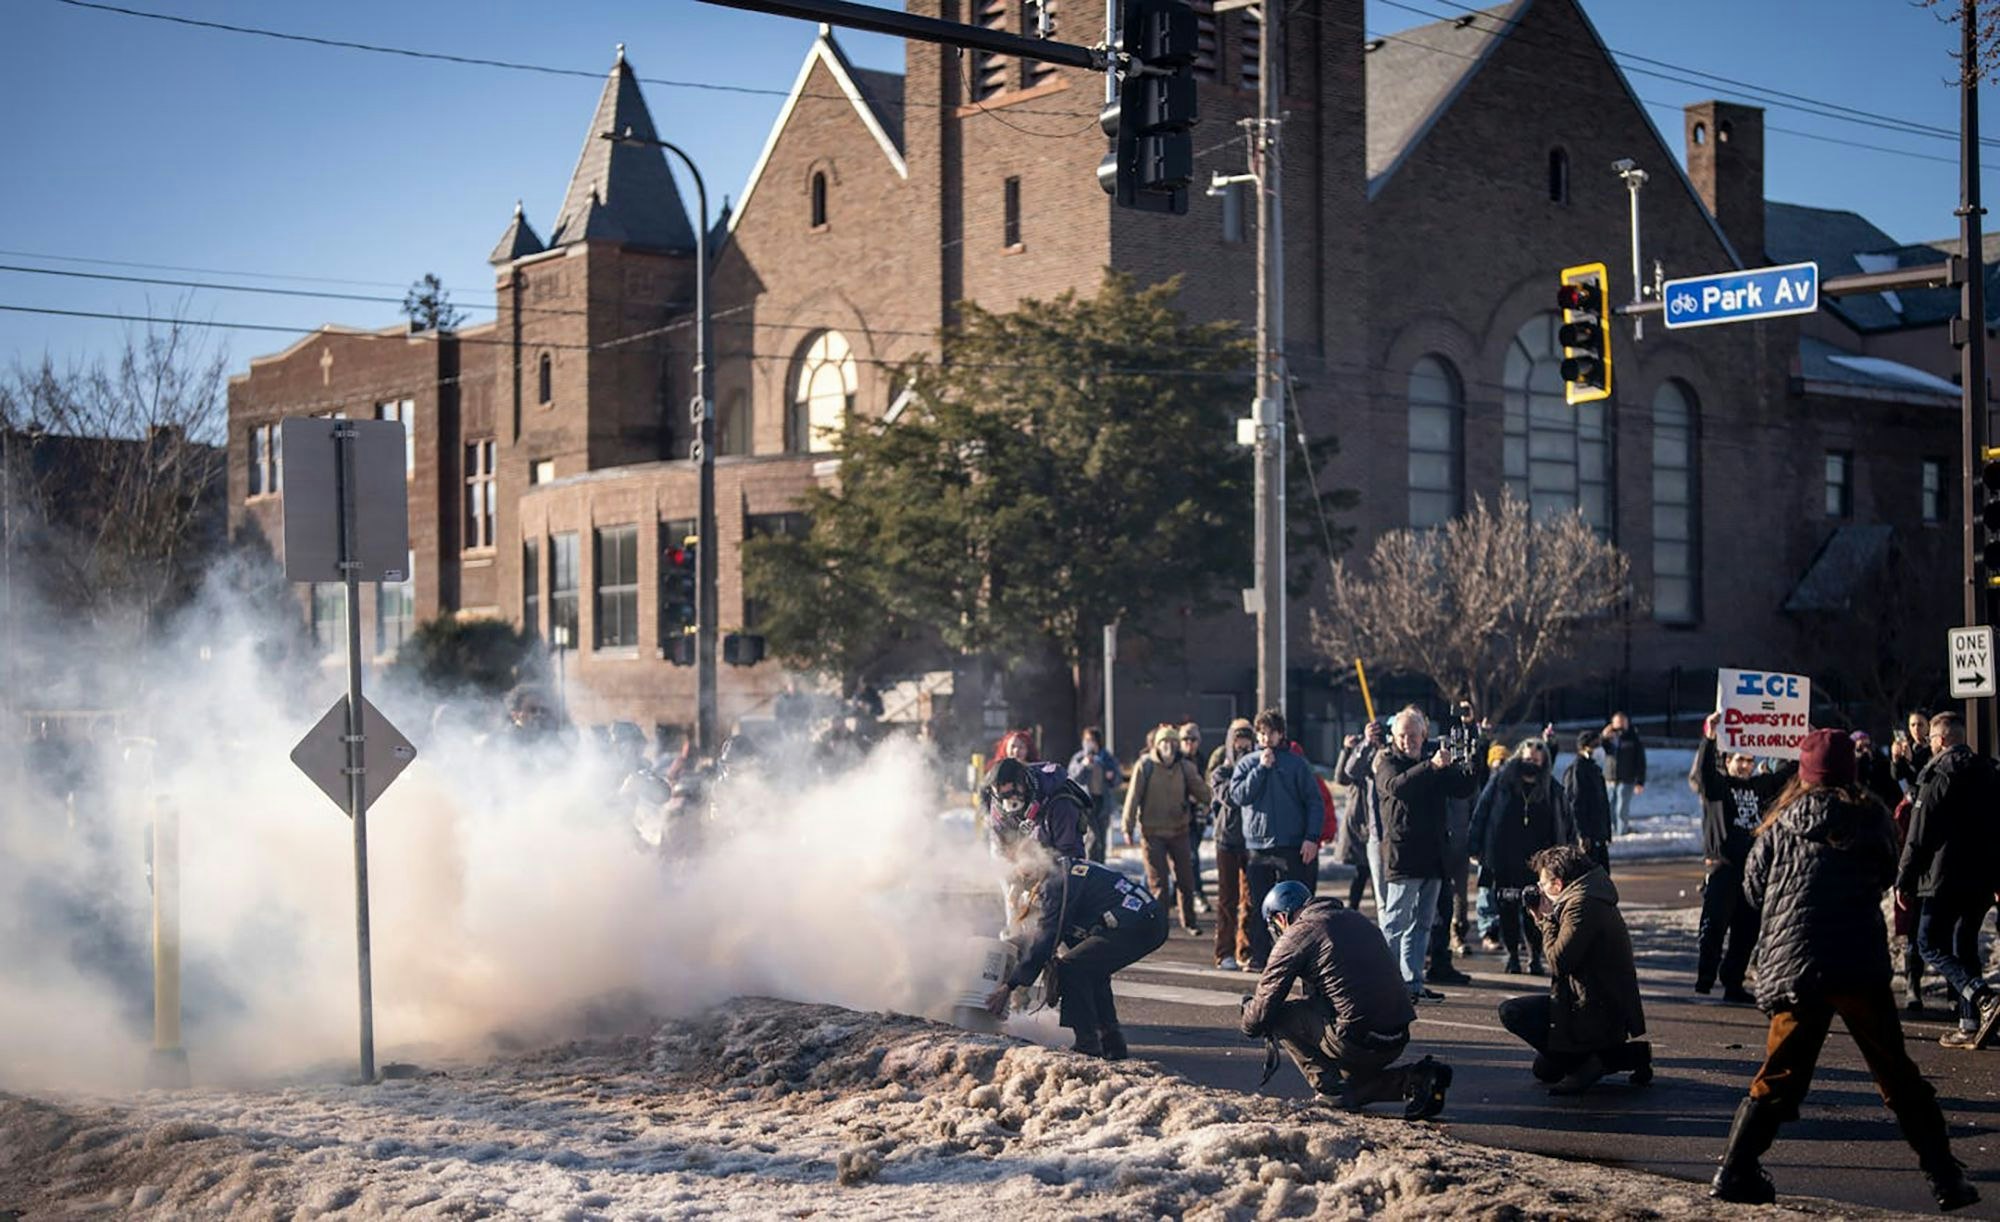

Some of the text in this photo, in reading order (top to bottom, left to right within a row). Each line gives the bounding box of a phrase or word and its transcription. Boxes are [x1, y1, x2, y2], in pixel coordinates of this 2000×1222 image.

[1702, 276, 1811, 314] Park Av
[1955, 633, 1987, 652] ONE
[1955, 652, 1987, 669] WAY
[1736, 673, 1800, 699] ICE
[1724, 708, 1806, 728] DOMESTIC
